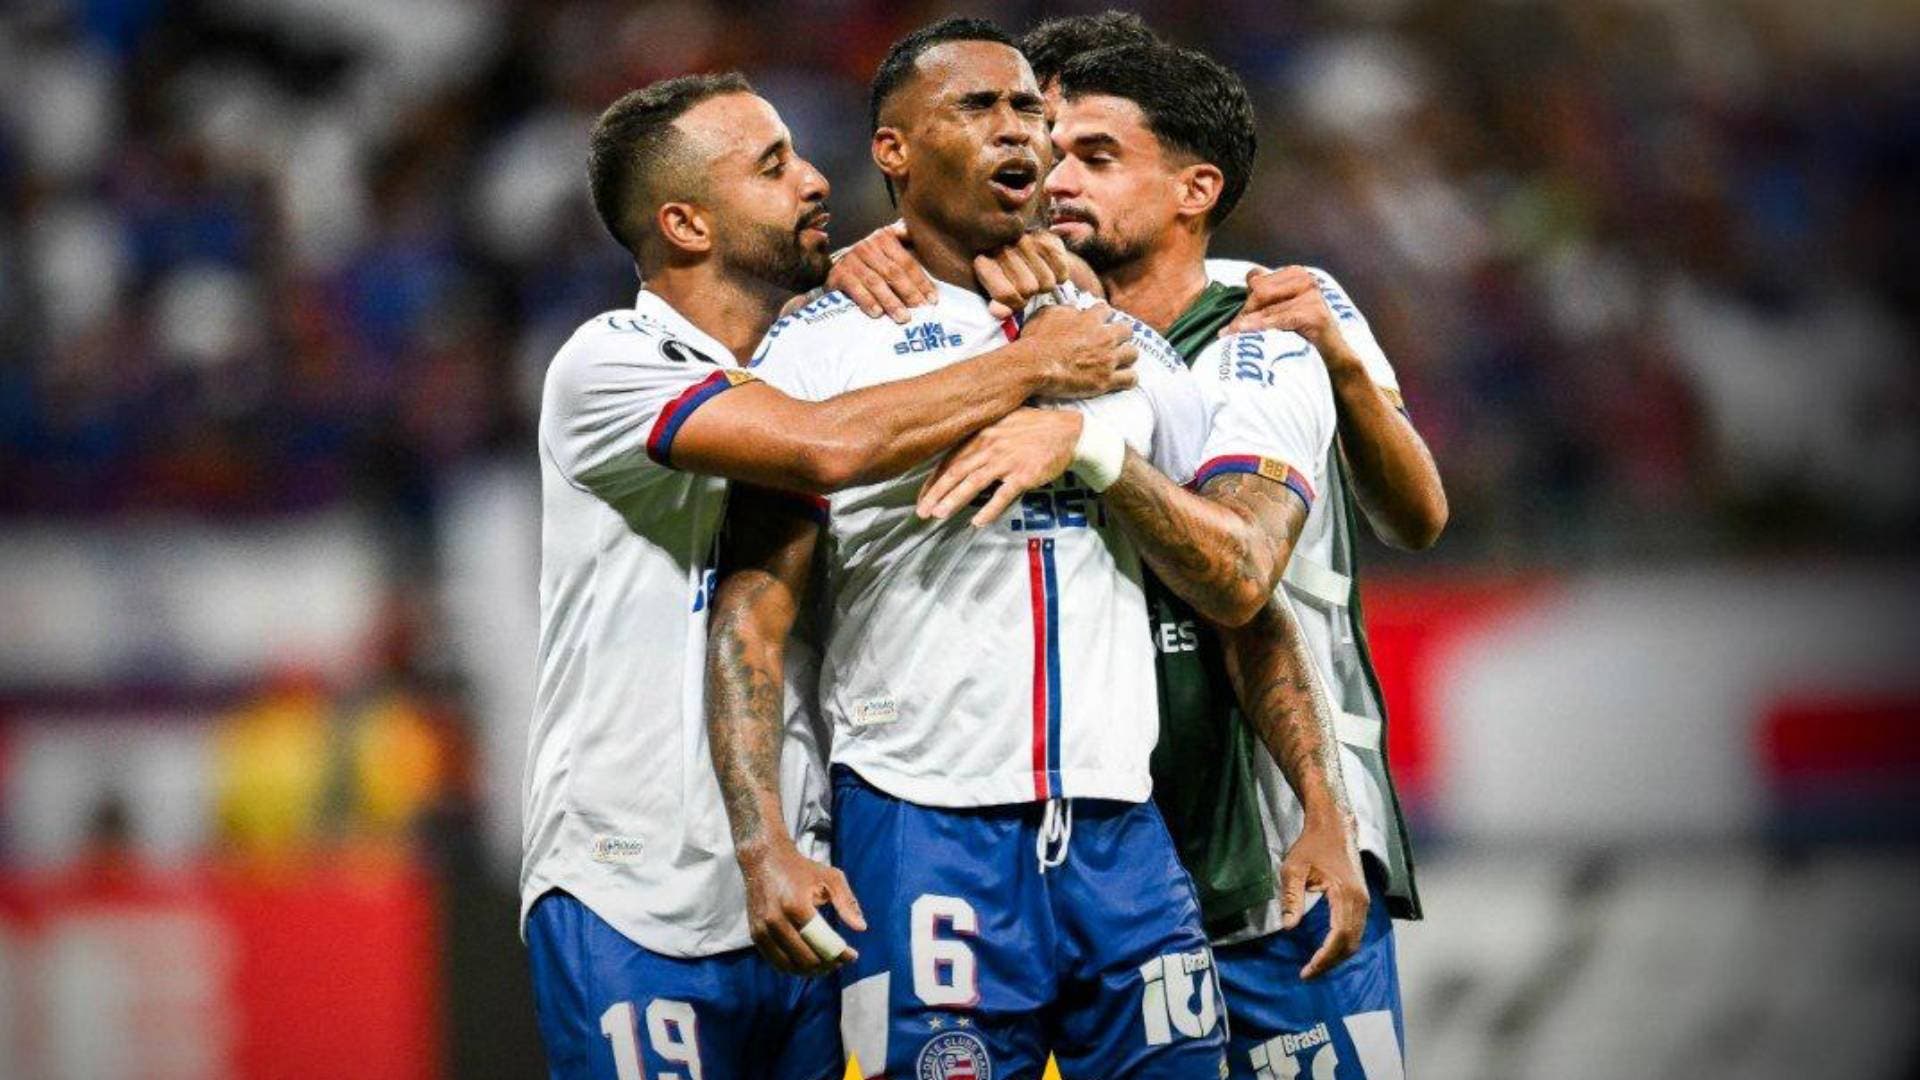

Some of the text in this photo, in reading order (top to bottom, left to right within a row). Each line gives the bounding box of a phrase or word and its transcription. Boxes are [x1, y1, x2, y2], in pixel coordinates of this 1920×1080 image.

[893, 334, 962, 355] SORTE
[1154, 621, 1199, 653] ES
[911, 894, 981, 1008] 6
[599, 998, 703, 1080] 19
[1282, 1022, 1332, 1057] Brasil
